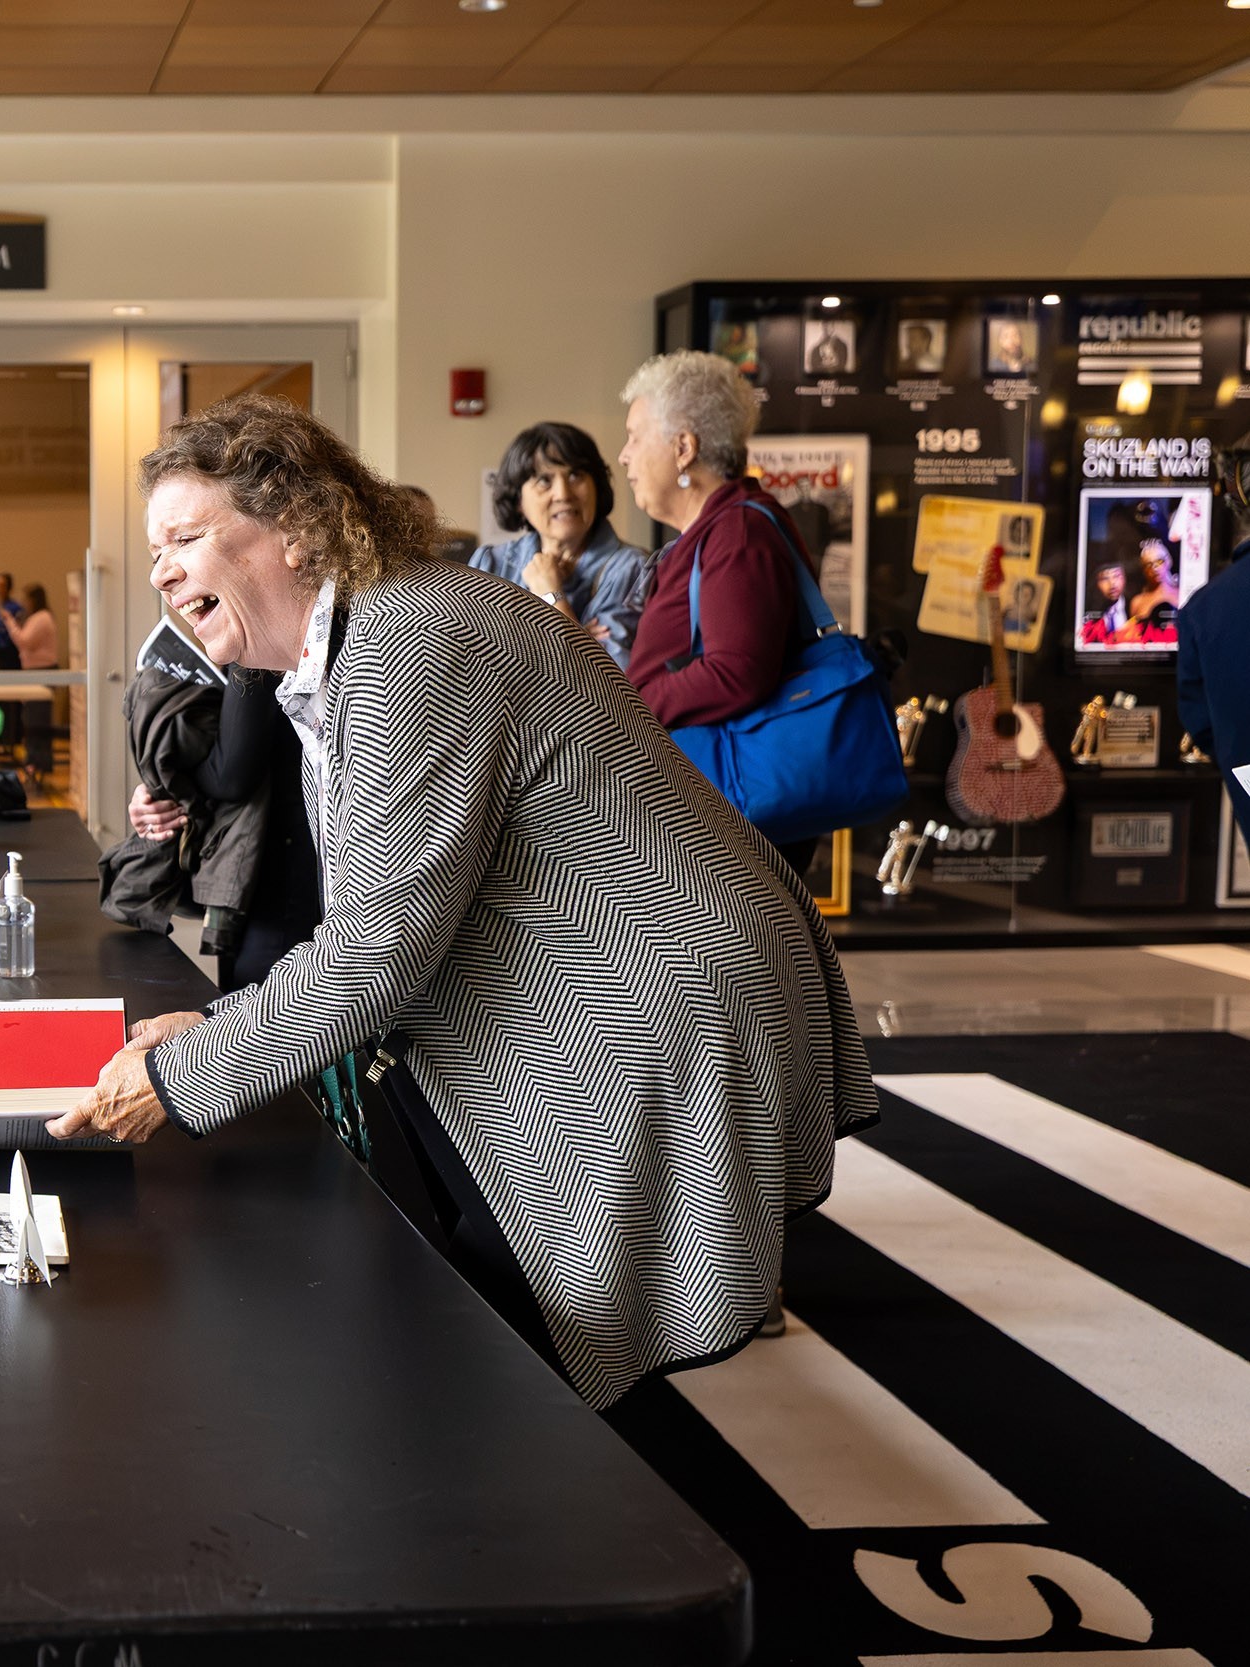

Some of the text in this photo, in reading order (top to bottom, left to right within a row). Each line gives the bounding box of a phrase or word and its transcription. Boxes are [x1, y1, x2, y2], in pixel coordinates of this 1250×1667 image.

[1078, 311, 1202, 341] republic
[1083, 437, 1212, 459] SKUZLAND IS
[1082, 456, 1210, 478] ON THE WAY!
